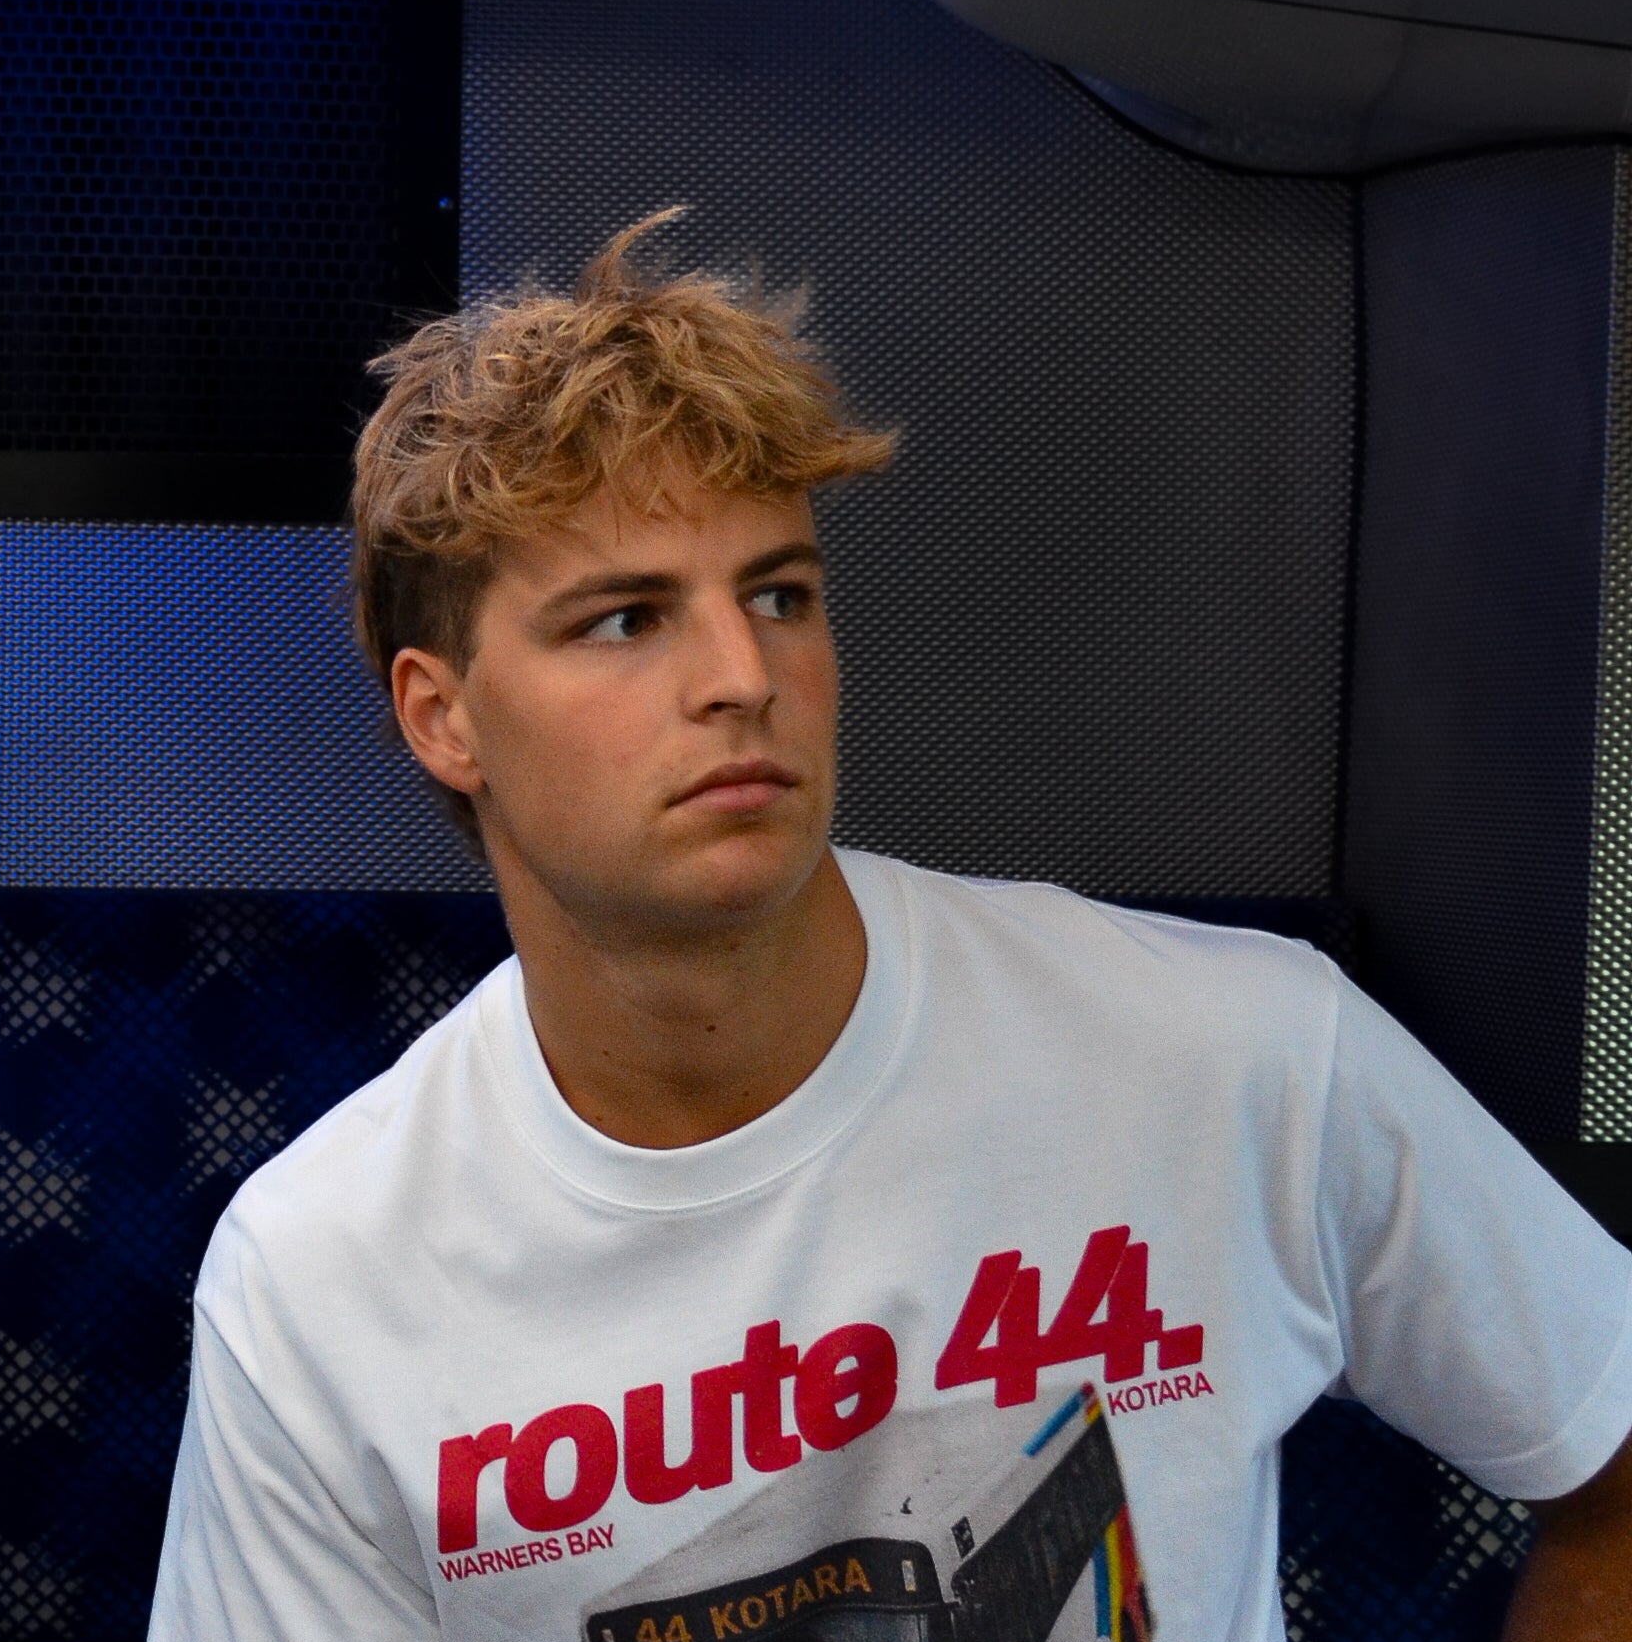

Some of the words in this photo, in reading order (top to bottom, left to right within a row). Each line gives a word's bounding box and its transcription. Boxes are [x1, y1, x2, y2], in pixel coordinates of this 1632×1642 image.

[1106, 1370, 1215, 1417] KOTARA
[436, 1318, 899, 1556] route
[437, 1536, 564, 1583] WARNERS
[564, 1525, 617, 1557] BAY
[708, 1557, 873, 1642] KOTARA
